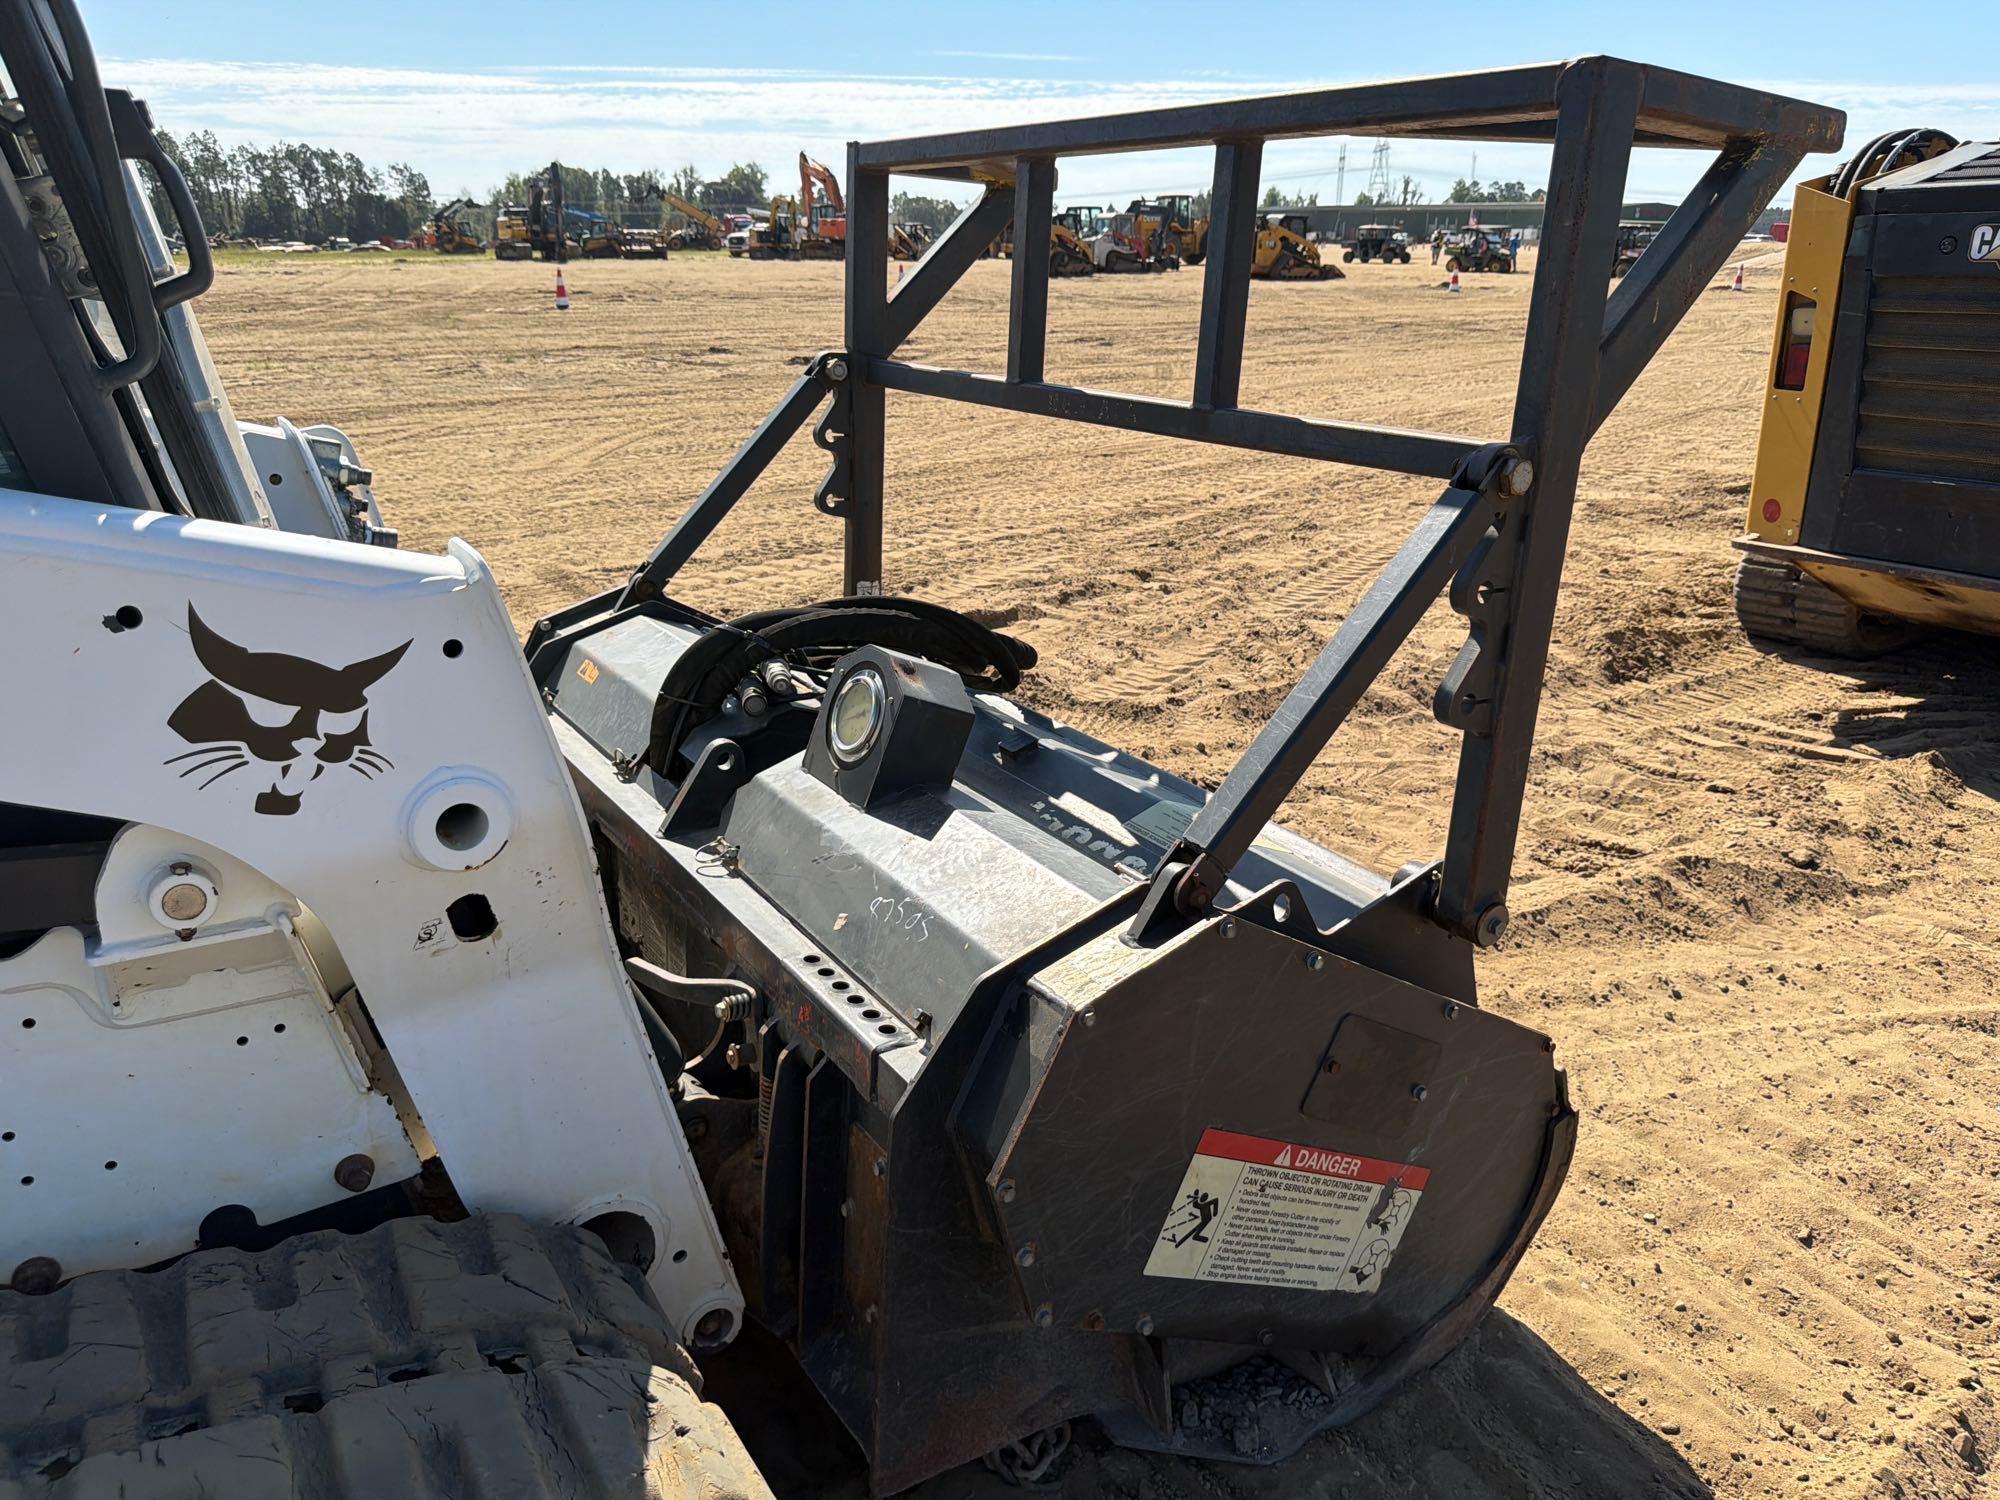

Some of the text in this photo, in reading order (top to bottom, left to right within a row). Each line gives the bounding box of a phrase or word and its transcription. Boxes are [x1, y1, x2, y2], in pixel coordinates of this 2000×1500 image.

[1295, 1149, 1362, 1177] DANGER
[1246, 1166, 1373, 1192] THROWN OBJECTS OR ROTATING DRUM
[1241, 1176, 1369, 1202] CAN CAUSE SERIOUS INJURY OR DEATH
[1268, 1193, 1288, 1202] objects
[1249, 1207, 1270, 1216] operate
[1269, 1210, 1290, 1219] Forestry
[1317, 1216, 1335, 1225] vicinity
[1254, 1233, 1272, 1241] engine
[1275, 1236, 1296, 1244] running.
[1284, 1229, 1303, 1237] objects
[1209, 1263, 1235, 1271] damaged.
[1229, 1256, 1248, 1264] cutting
[1270, 1260, 1294, 1268] mounting
[1316, 1264, 1335, 1272] Replace
